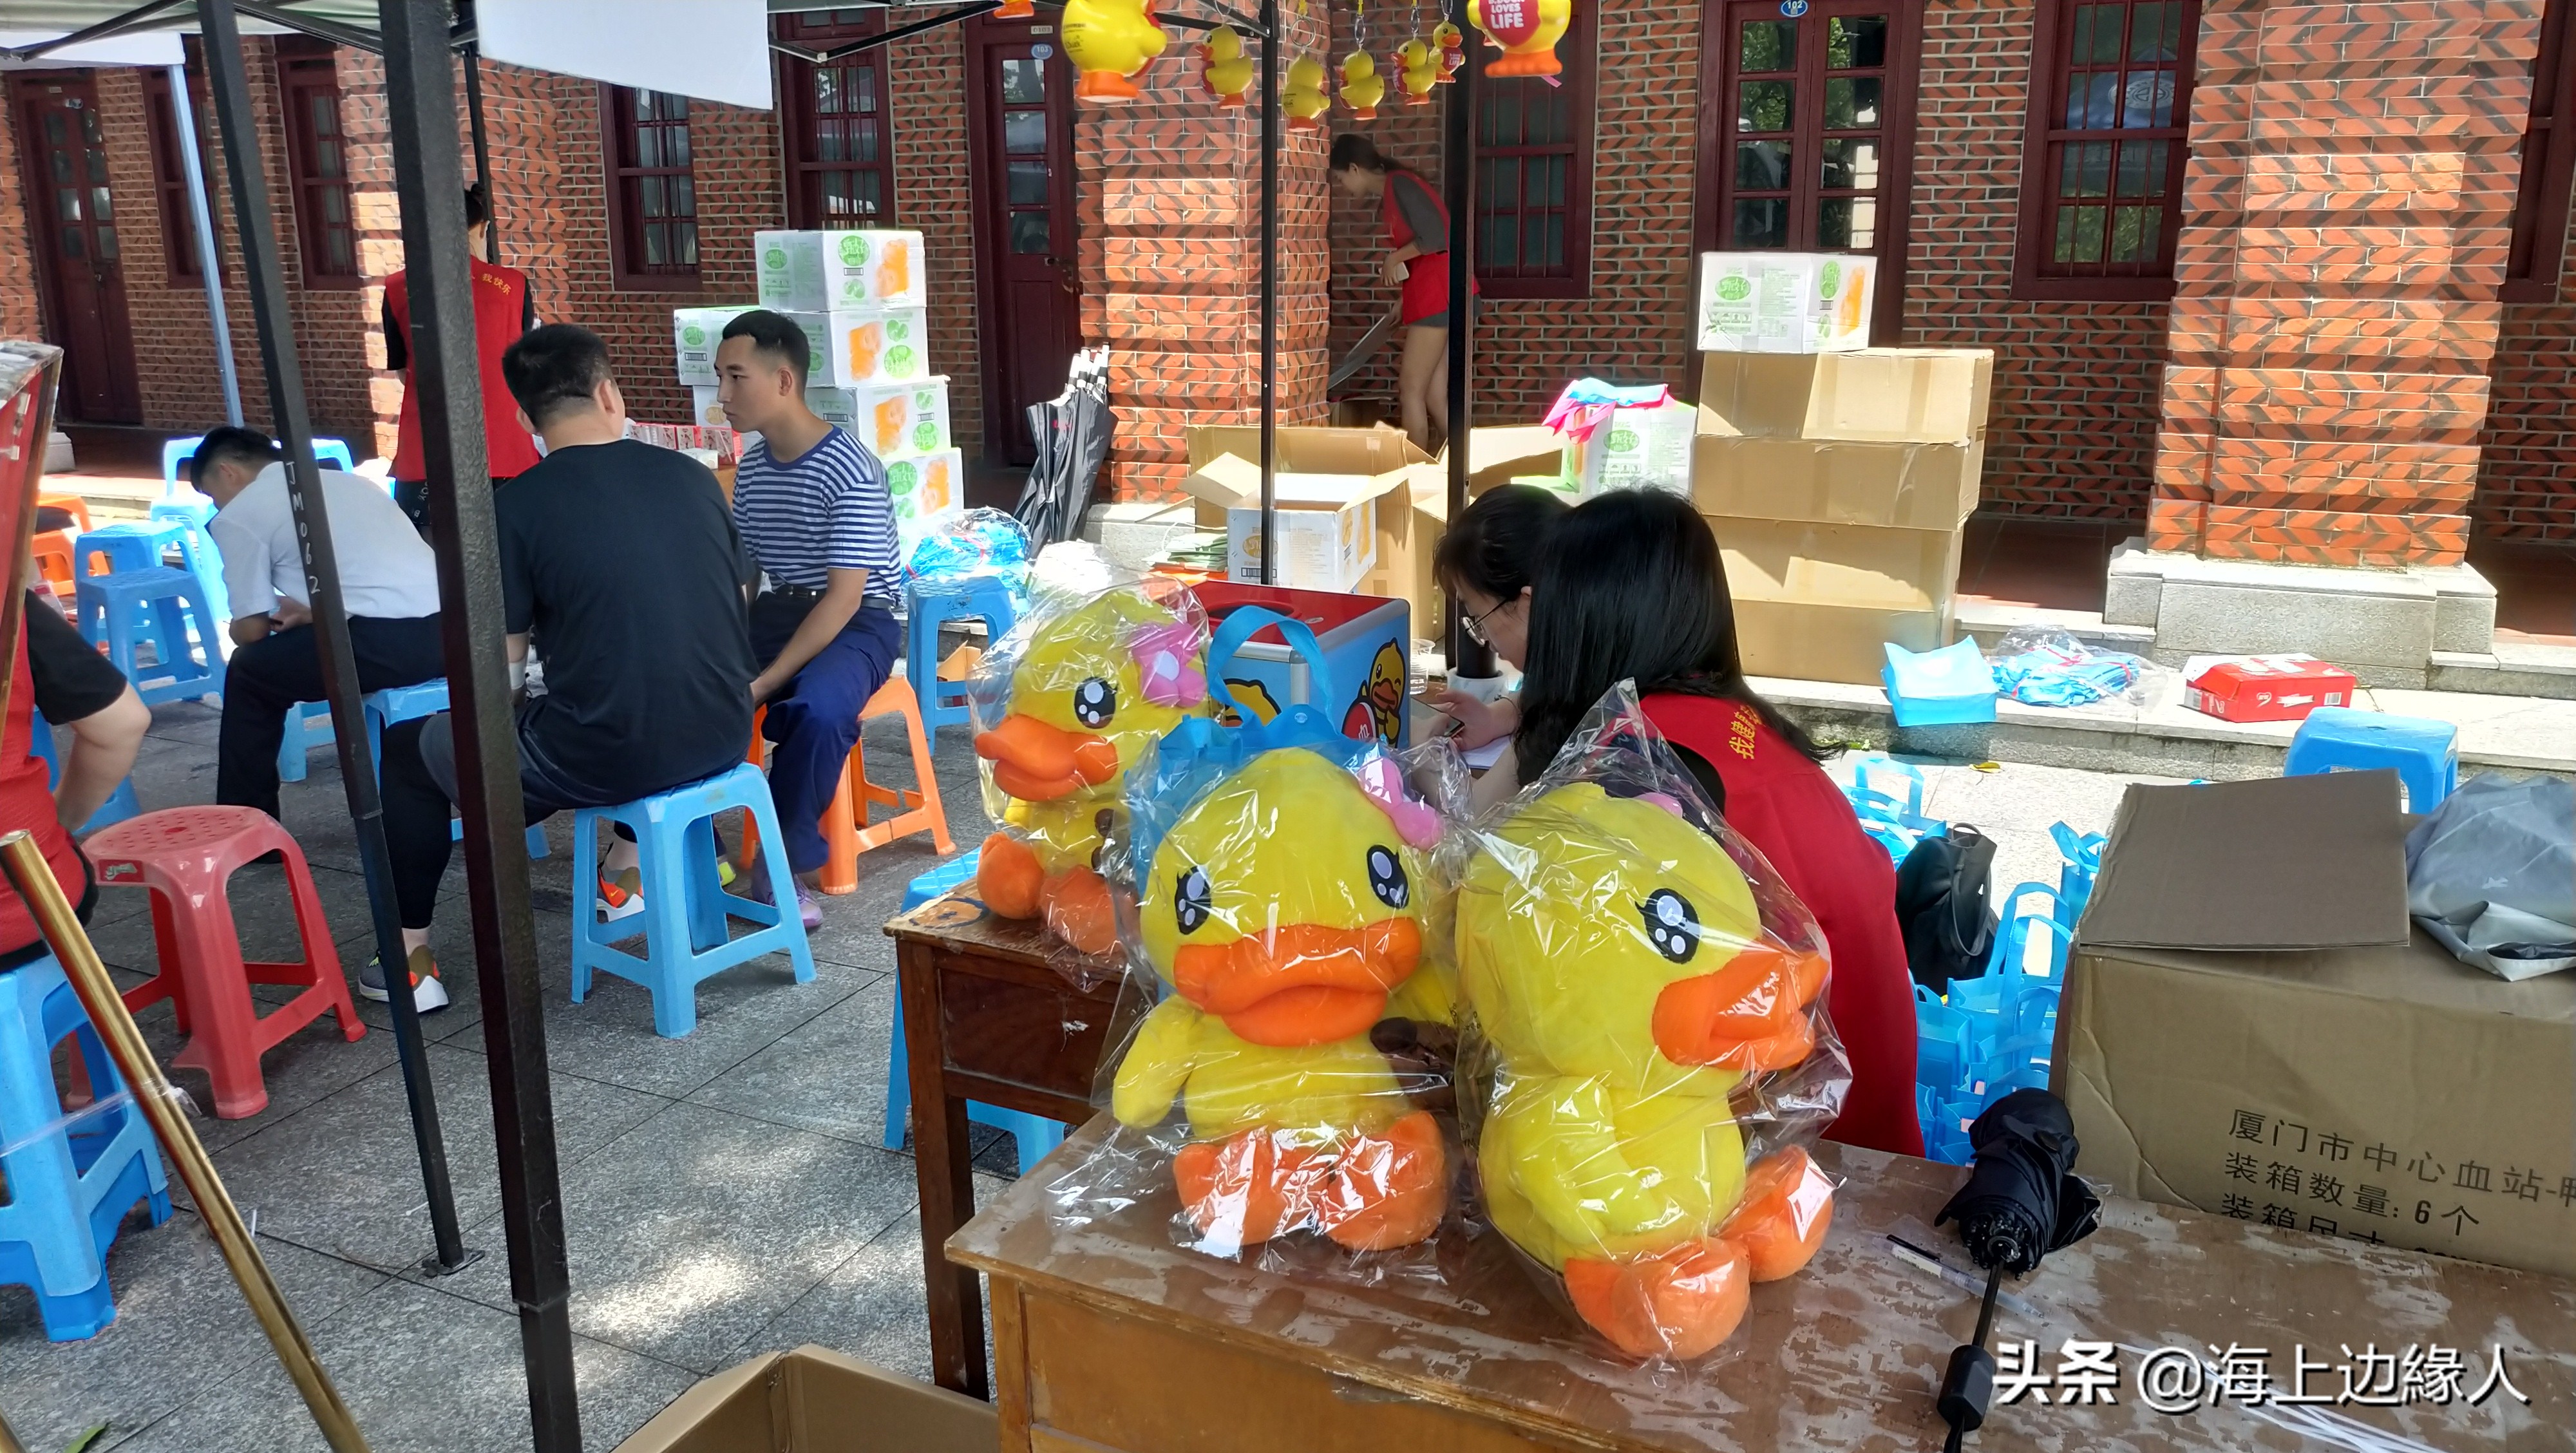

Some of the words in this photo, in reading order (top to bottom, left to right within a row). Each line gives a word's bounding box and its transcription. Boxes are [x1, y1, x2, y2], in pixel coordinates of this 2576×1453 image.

[1491, 3, 1520, 13] LOVES
[1787, 1, 1803, 9] 102
[1490, 12, 1524, 29] LIFE
[482, 273, 512, 296] 我快乐
[285, 461, 321, 595] JM062
